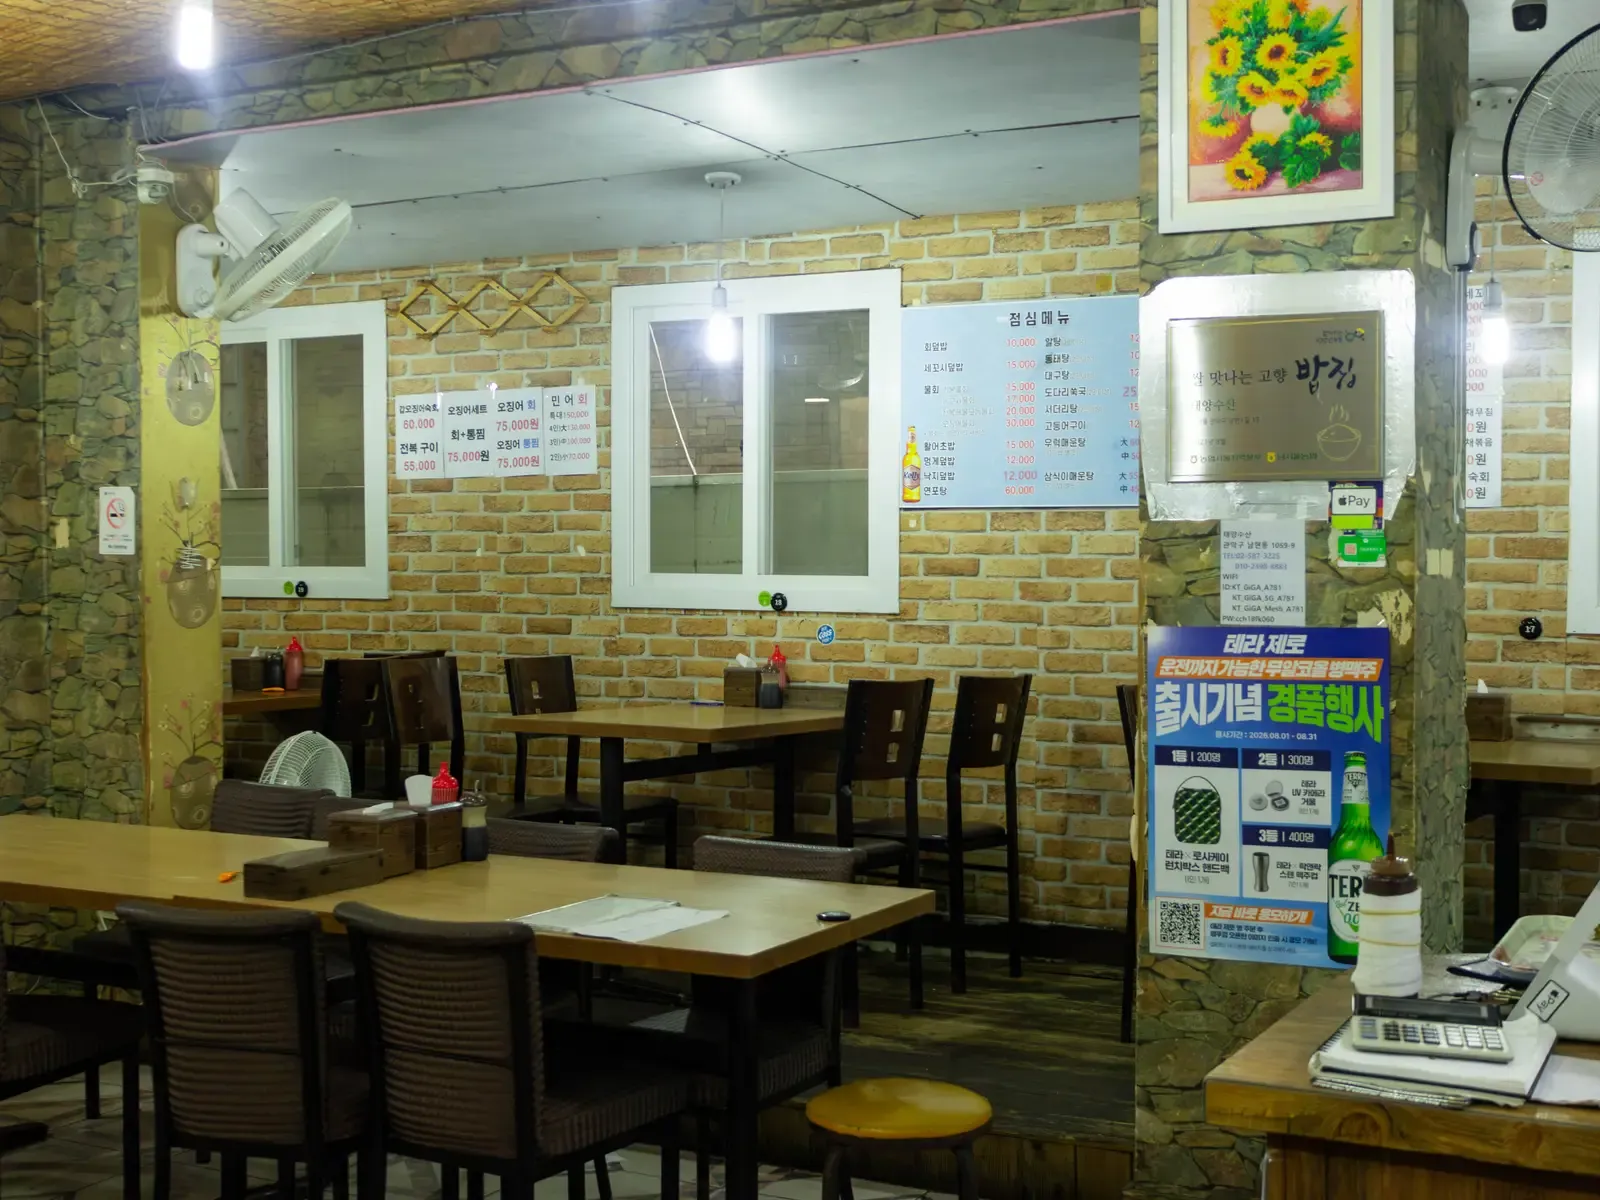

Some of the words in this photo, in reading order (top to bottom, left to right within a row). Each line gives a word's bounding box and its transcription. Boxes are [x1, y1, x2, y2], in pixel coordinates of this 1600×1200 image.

[924, 342, 947, 352] 회덮밥
[1045, 370, 1070, 380] 대구탕
[1209, 370, 1252, 386] 맛나는
[1259, 368, 1289, 385] 고향
[1295, 354, 1356, 397] 밥집
[448, 404, 488, 415] 오징어세트
[498, 400, 523, 412] 오징어
[527, 400, 536, 410] 회
[1045, 404, 1078, 413] 서더리탕
[404, 419, 435, 430] 60,000
[496, 418, 539, 432] 75,000원
[1045, 421, 1086, 431] 고등어구이
[451, 428, 485, 440] 회+통찜
[400, 443, 417, 454] 전복
[420, 442, 438, 454] 구이
[497, 439, 520, 450] 오징어
[1045, 437, 1086, 447] 우럭매운탕
[448, 450, 489, 462] 75,000원
[497, 455, 540, 468] 75,000원
[404, 460, 436, 471] 55,000
[924, 471, 955, 481] 낙지덮밥
[924, 487, 947, 496] 연포탕
[1348, 496, 1370, 508] Pay
[1525, 625, 1536, 633] 17
[1223, 634, 1264, 654] 테라
[1265, 634, 1308, 655] 제로
[1159, 659, 1217, 676] 운전까지
[1217, 660, 1265, 677] 가능한
[1266, 660, 1329, 678] 무알코올
[1329, 661, 1378, 678] 병맥주
[1155, 681, 1262, 737] 출시기념
[1267, 683, 1384, 744] 경품행사
[1172, 750, 1187, 762] 1등
[1197, 751, 1220, 763] 200명
[1258, 753, 1278, 766] 2등
[1288, 755, 1314, 765] 300명
[1259, 829, 1278, 843] 3등
[1289, 831, 1314, 843] 400명
[1165, 849, 1183, 860] 테라
[1193, 852, 1229, 863] 로사케이
[1165, 860, 1201, 872] 런치박스
[1202, 863, 1230, 875] 핸드백
[1329, 874, 1362, 898] TER
[1211, 904, 1232, 918] 지금
[1233, 905, 1258, 920] 바로
